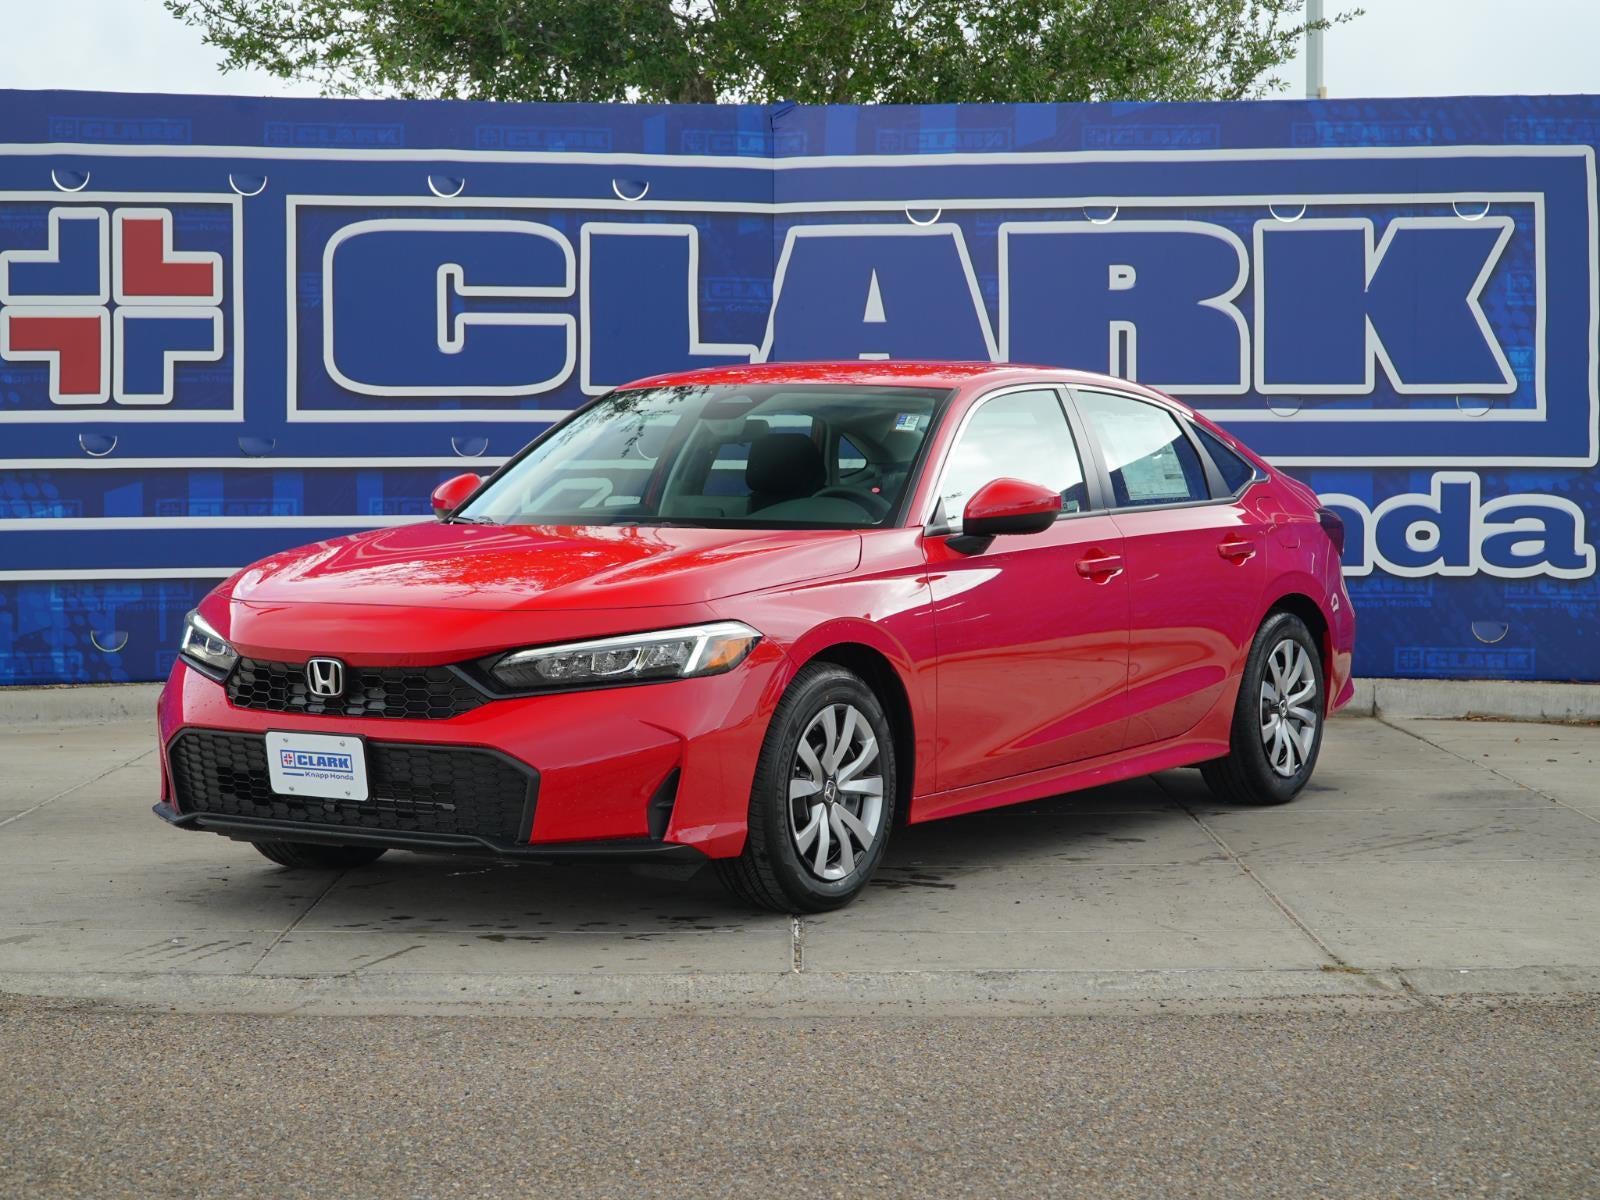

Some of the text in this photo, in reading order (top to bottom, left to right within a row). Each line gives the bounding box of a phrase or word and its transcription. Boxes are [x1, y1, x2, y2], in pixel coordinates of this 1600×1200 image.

[322, 216, 1518, 398] CLARK
[1318, 471, 1597, 580] nda
[296, 754, 350, 769] CLARK
[304, 771, 354, 781] Knapp Honda
